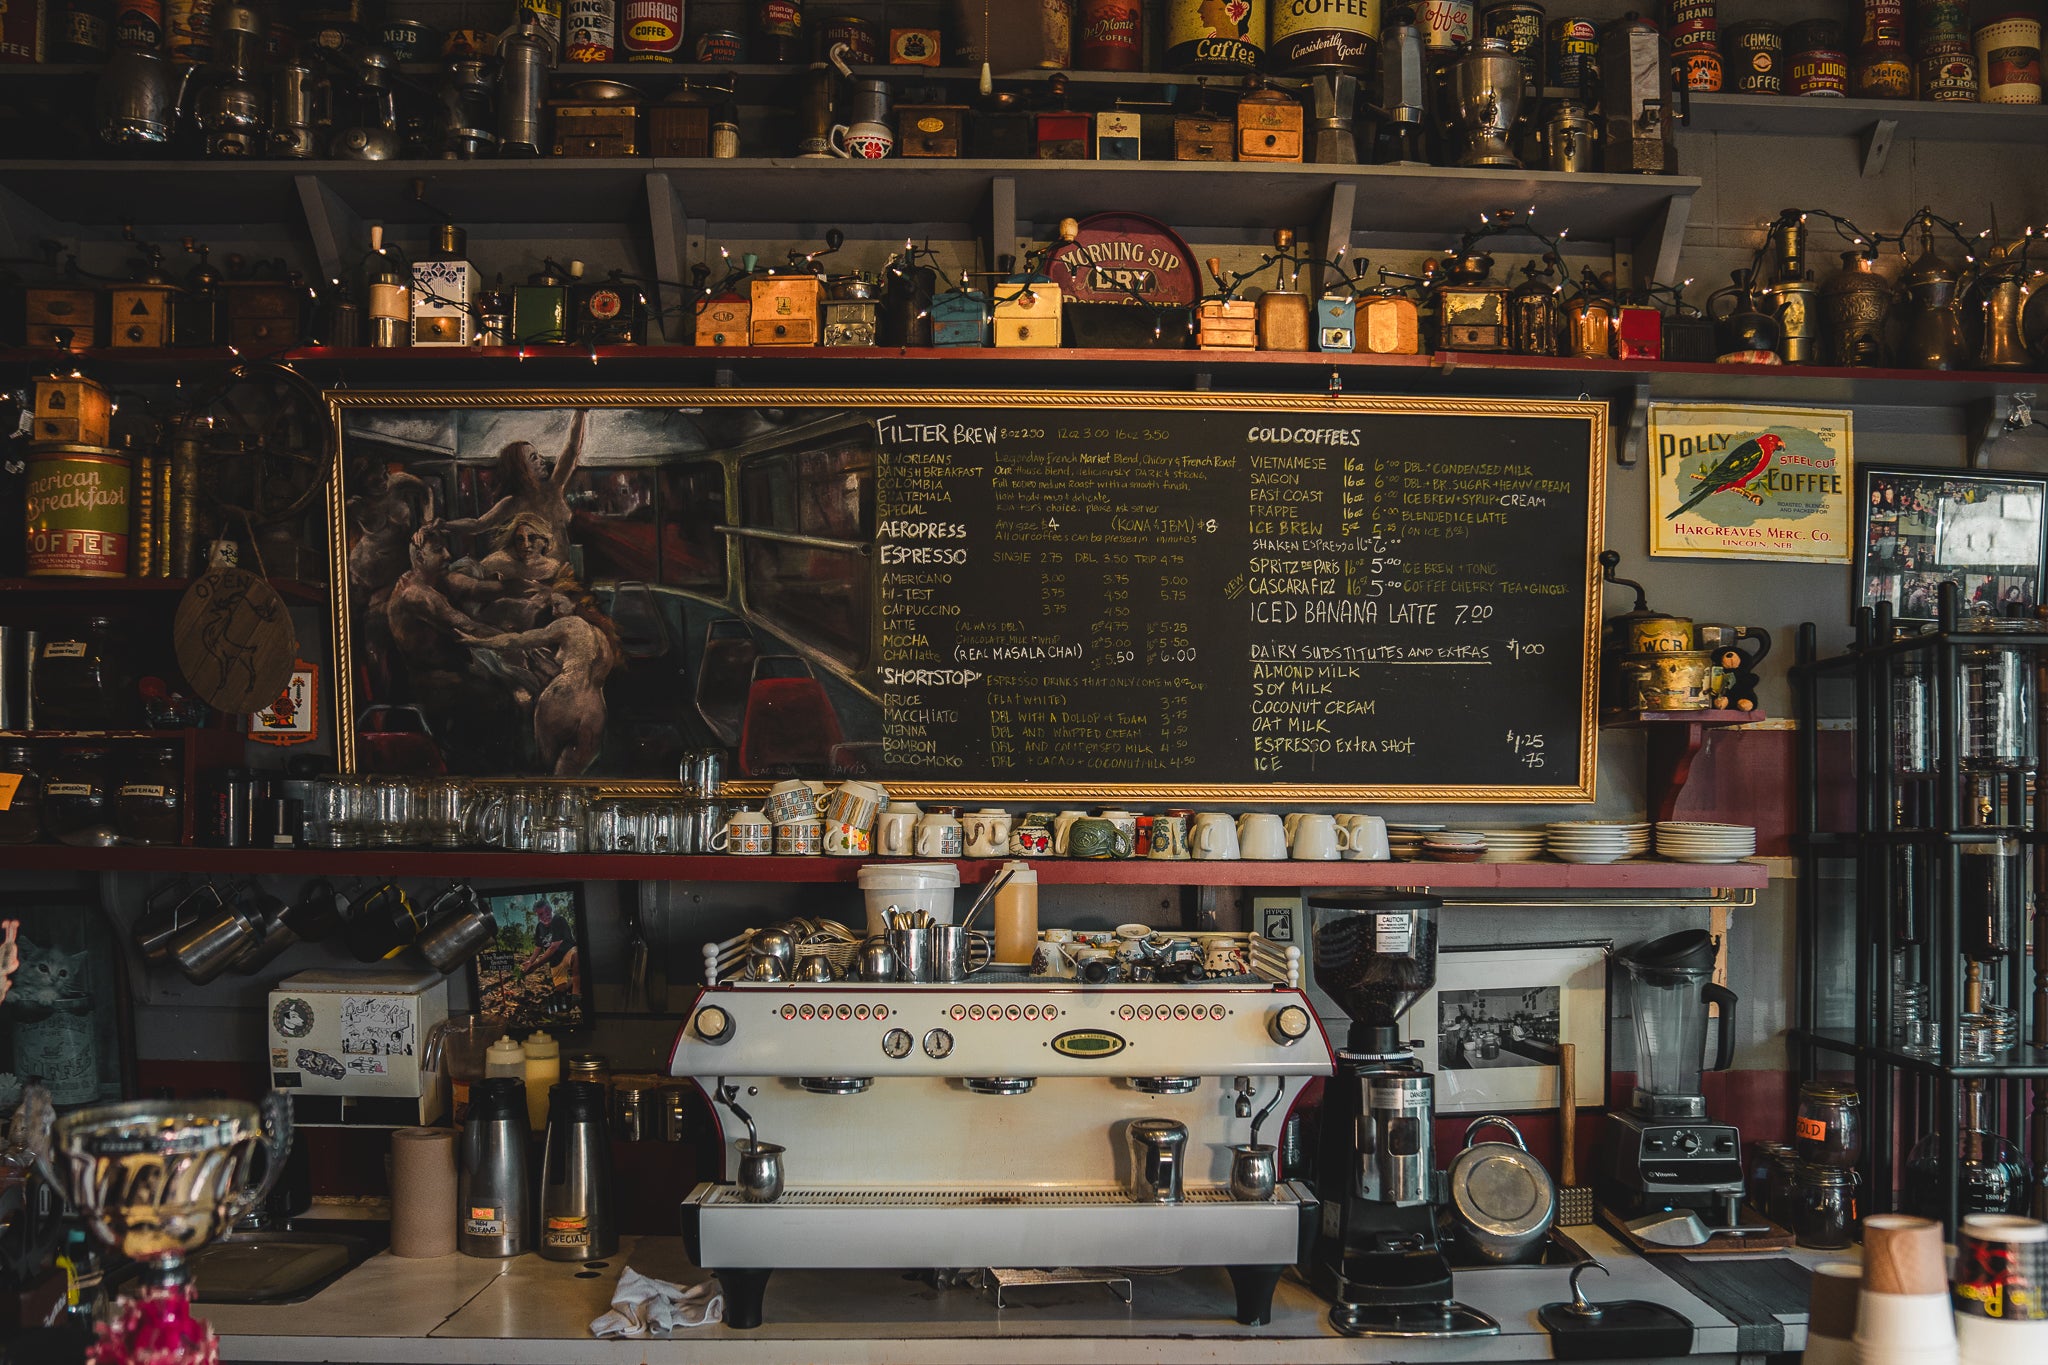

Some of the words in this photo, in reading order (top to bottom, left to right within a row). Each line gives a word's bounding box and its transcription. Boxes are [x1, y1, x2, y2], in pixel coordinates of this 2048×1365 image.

[568, 2, 601, 13] KING
[626, 2, 678, 24] EDWARDS
[1291, 0, 1368, 18] COFFEE
[1415, 0, 1468, 31] Coffee
[1677, 7, 1714, 23] BRAND
[568, 17, 600, 30] COLE
[635, 26, 666, 37] COFFEE
[1100, 17, 1134, 31] Monte
[1099, 35, 1133, 44] COFFEE
[1291, 32, 1343, 60] Consistently
[1338, 43, 1367, 60] Good!
[1674, 31, 1716, 47] COFFEE
[1196, 39, 1256, 63] Coffee
[1793, 63, 1815, 79] OLD
[1817, 62, 1847, 79] JUDGE
[1739, 75, 1781, 91] COFFEE
[1800, 81, 1845, 91] COFFEE
[1930, 79, 1955, 88] RED
[1934, 90, 1977, 100] COFFEE
[1060, 242, 1144, 272] MORNING
[1148, 248, 1180, 272] SIP
[877, 415, 949, 445] FILTER
[953, 424, 997, 445] BREW
[903, 453, 952, 465] ORLEANS
[1659, 433, 1731, 478] POLLY
[1780, 455, 1813, 467] STEEL
[1815, 458, 1836, 469] CUT
[923, 466, 984, 478] BREAKFAST
[1250, 456, 1327, 470] VIETNAMESE
[1504, 464, 1534, 477] MILK
[1250, 473, 1299, 485] SAIGON
[1768, 468, 1843, 494] COFFEE
[27, 486, 126, 521] Breakfast
[1424, 493, 1456, 505] BREW
[1500, 494, 1546, 507] CREAM
[878, 502, 927, 517] SPECIAL
[1249, 505, 1298, 519] FRAPPE
[1476, 512, 1508, 525] LATTE
[876, 520, 967, 540] AEROPRESS
[1249, 522, 1274, 535] ICE
[1279, 522, 1323, 535] BREW
[1675, 523, 1762, 539] HARGREAVES
[1767, 527, 1806, 541] MERC.
[1252, 539, 1299, 552] SHAKEN
[1773, 541, 1793, 549] NEB
[880, 544, 967, 565] ESPRESSO
[882, 572, 952, 585] AMERICANO
[1223, 573, 1245, 596] NEW
[1249, 578, 1310, 596] CASCARA
[1499, 581, 1523, 594] TEA
[1529, 583, 1569, 596] GINGER
[882, 604, 961, 617] CAPPUCCINO
[1251, 600, 1298, 624] ICED
[1305, 600, 1378, 624] BANANA
[1389, 603, 1438, 625] LATTE
[1454, 604, 1493, 625] 7.00
[883, 619, 916, 631] LATTE
[882, 635, 930, 648] MOCHA
[954, 645, 989, 663] (REAL
[993, 647, 1045, 661] MASALA
[1048, 643, 1083, 660] CHAI)
[1160, 647, 1197, 662] 6.00
[1301, 645, 1404, 661] SUBSTITUTES
[1407, 647, 1434, 658] AND
[1438, 645, 1490, 659] EXTRAS
[1254, 662, 1314, 679] ALMOND
[1318, 663, 1360, 679] MILK
[986, 675, 1039, 687] ESPRESSO
[1253, 682, 1285, 696] SOY
[1292, 680, 1333, 695] MILK
[884, 693, 922, 706] BRUCE
[1252, 698, 1322, 715] COCONUT
[1324, 699, 1376, 715] CREAM
[882, 723, 928, 737] VIENNA
[1252, 716, 1282, 732] OAT
[1288, 717, 1331, 733] MILK
[882, 737, 937, 753] BOMBON
[1254, 736, 1332, 753] ESPRESSO
[1506, 729, 1545, 754] $1.25
[1254, 755, 1283, 771] ICE
[551, 1233, 586, 1244] SPECIAL
